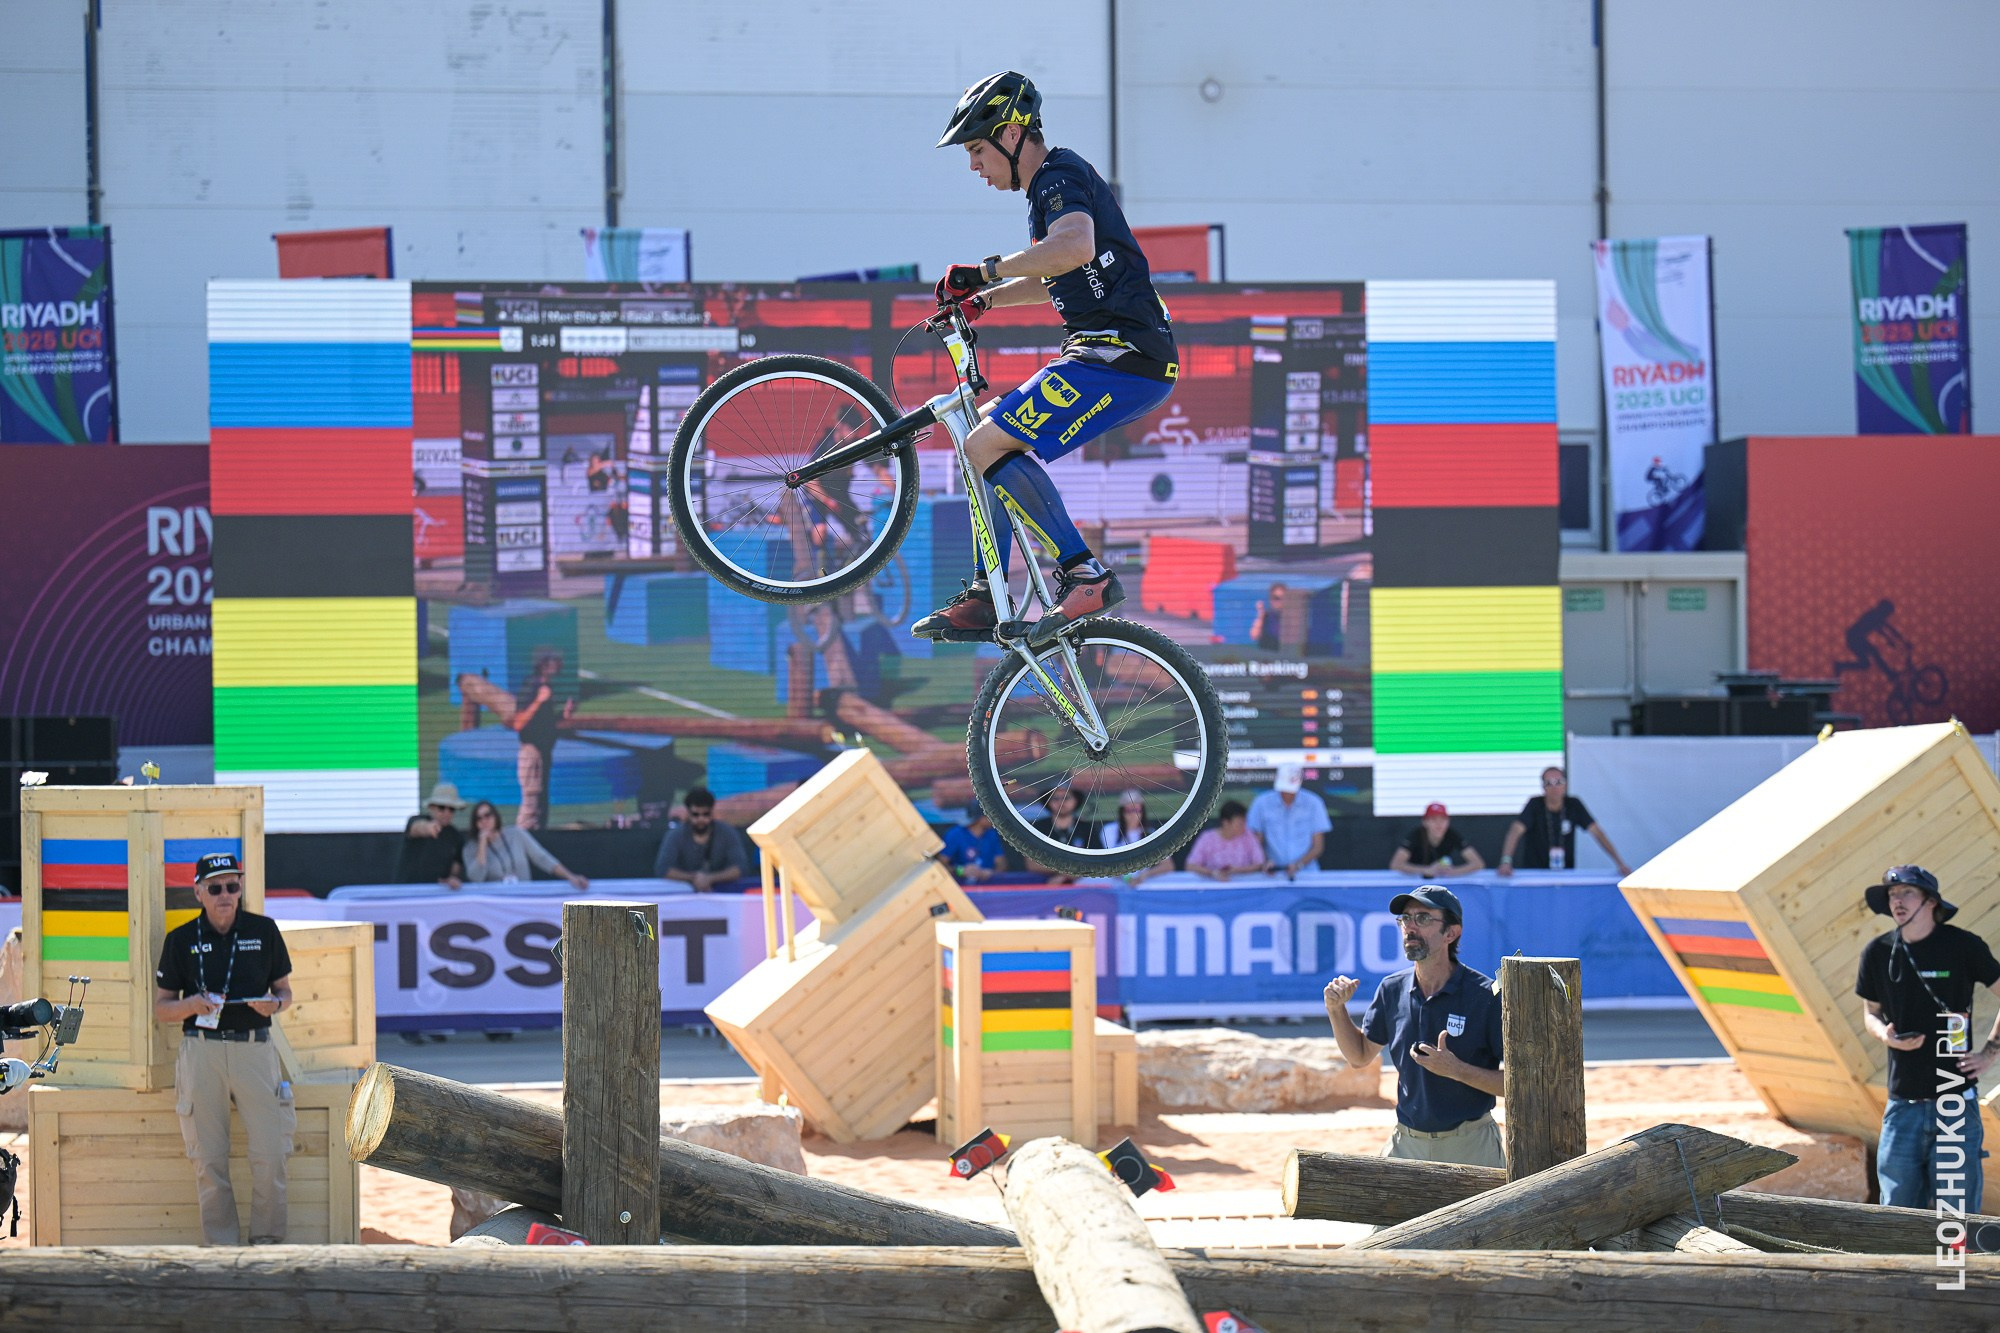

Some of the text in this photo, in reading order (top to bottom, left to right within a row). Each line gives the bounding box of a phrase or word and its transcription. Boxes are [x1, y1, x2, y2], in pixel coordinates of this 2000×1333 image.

[1082, 261, 1105, 299] ofidis
[1, 300, 99, 329] RIYADH
[1859, 292, 1956, 322] RIYADH
[3, 328, 102, 352] 2025 UCI
[1918, 319, 1958, 341] UCI
[4, 361, 103, 375] CHAMPIONSHIPS
[1612, 359, 1705, 387] RIYADH
[1046, 375, 1077, 403] WD-40
[1670, 386, 1704, 406] UCI
[1002, 411, 1038, 440] COMAS
[1058, 393, 1113, 446] COMAS
[148, 614, 207, 631] URBAN
[1248, 661, 1308, 679] Ranking
[213, 857, 231, 867] UCI
[374, 918, 728, 989] ISST
[1086, 910, 1415, 977] IMANO
